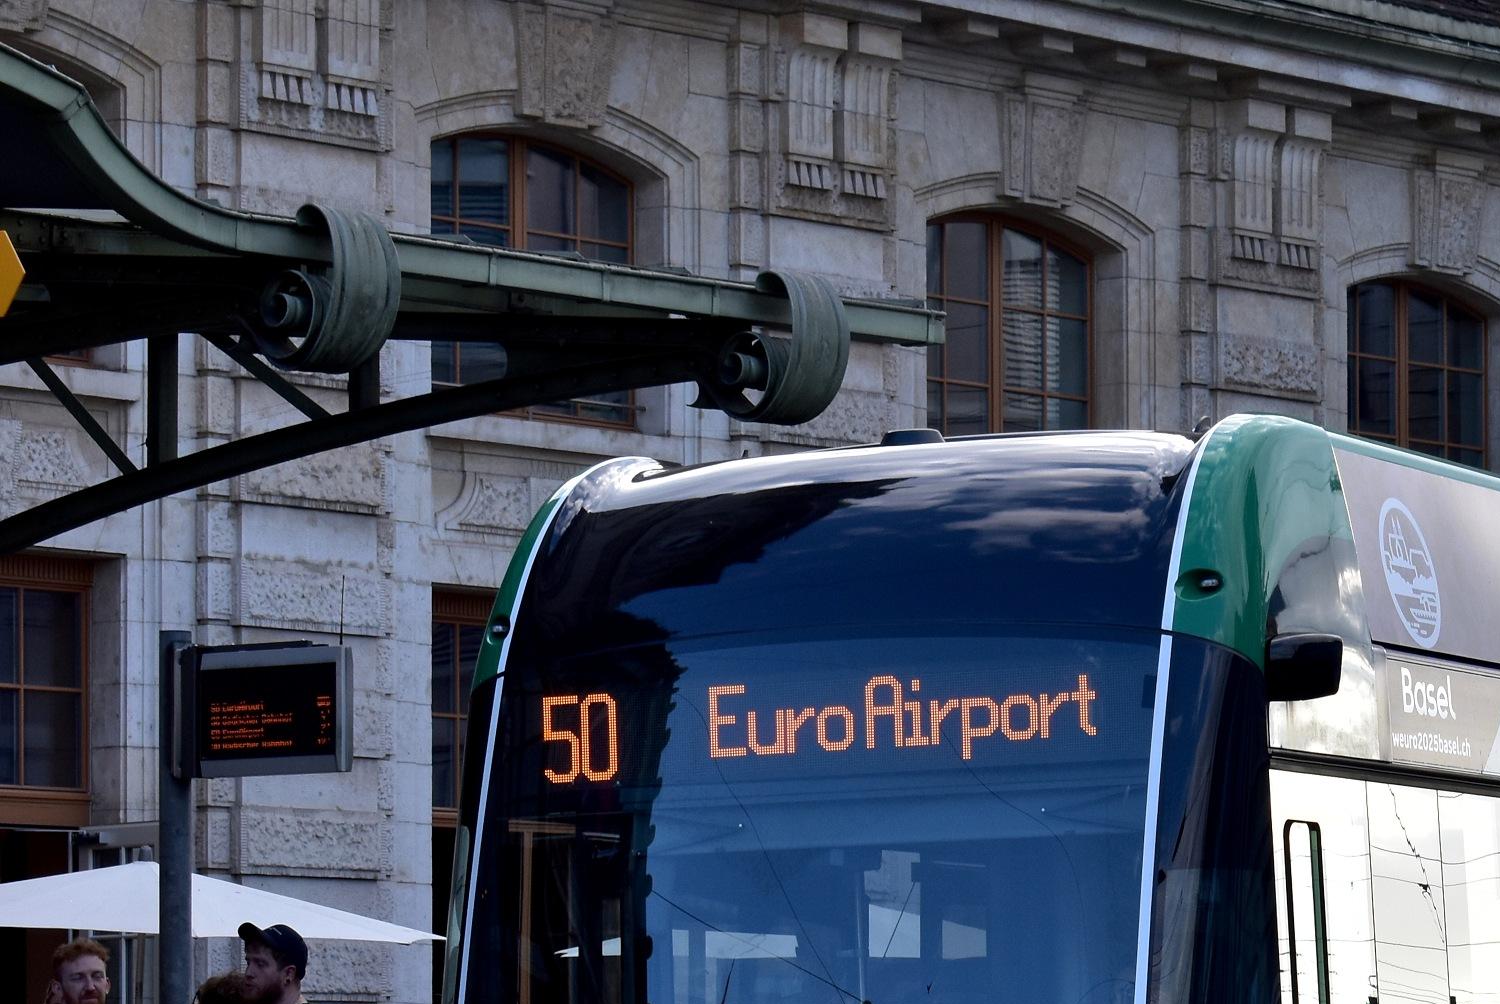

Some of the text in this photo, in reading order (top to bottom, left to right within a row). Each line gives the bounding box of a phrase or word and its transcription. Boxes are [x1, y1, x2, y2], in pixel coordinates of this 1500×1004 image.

[1400, 667, 1456, 720] Basel
[543, 693, 618, 783] 50
[1392, 732, 1471, 757] weuro2025basel.ch
